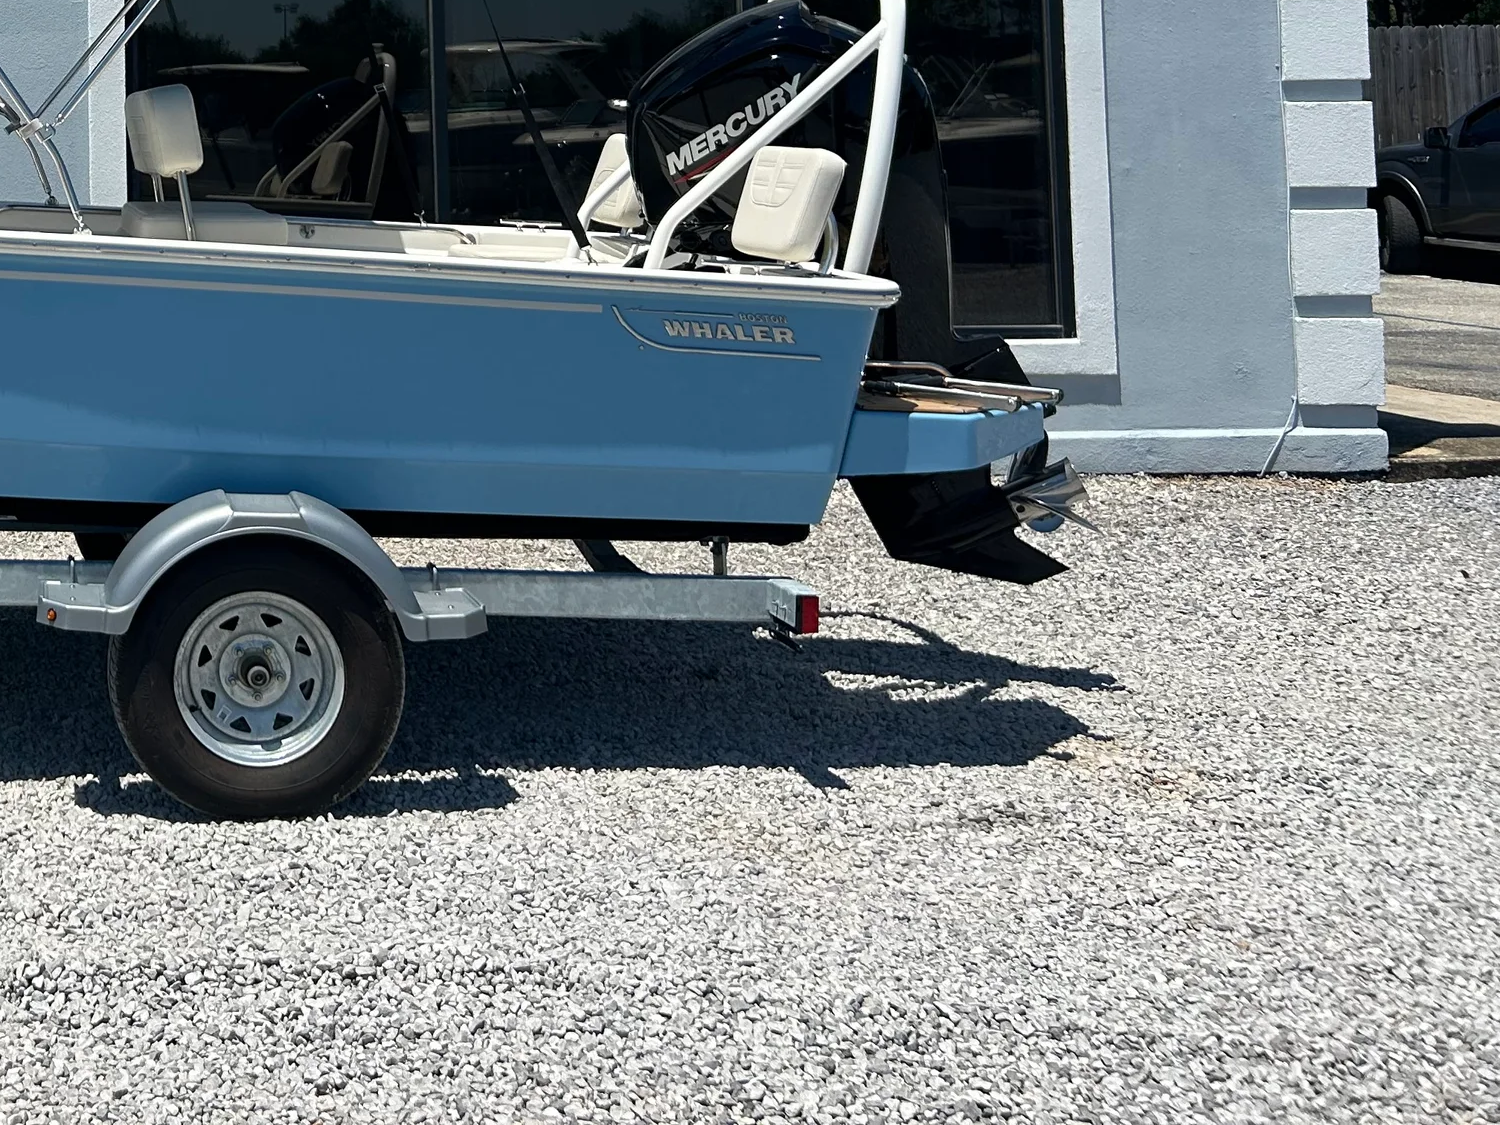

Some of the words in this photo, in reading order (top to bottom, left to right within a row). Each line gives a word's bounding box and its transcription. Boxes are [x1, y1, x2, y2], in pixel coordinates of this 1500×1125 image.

[665, 72, 801, 176] MERCURY
[738, 312, 788, 324] BOSTON
[663, 319, 796, 344] WHALER
